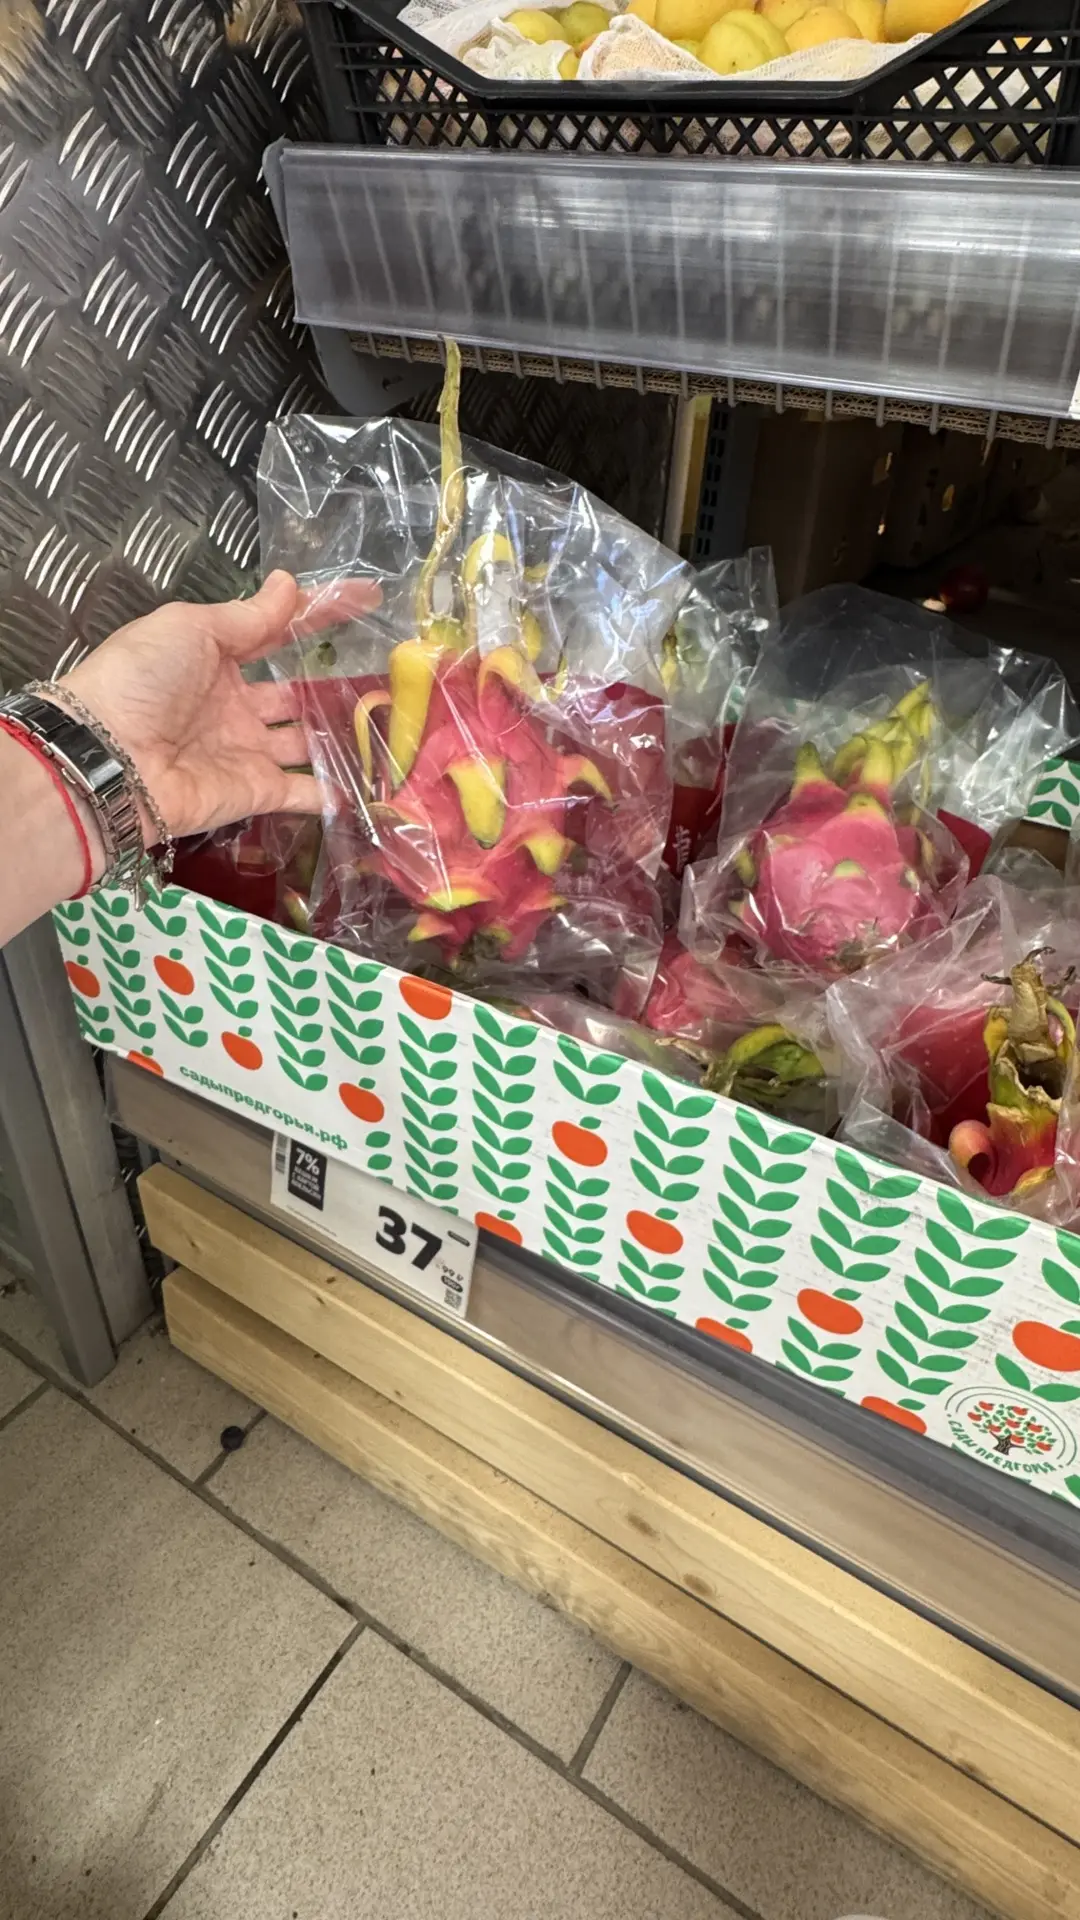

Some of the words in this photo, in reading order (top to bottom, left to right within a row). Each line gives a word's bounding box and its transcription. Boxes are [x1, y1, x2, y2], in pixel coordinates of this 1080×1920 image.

[179, 1065, 348, 1150] садыпредгорья.рф
[296, 1147, 320, 1176] 7%
[375, 1205, 443, 1271] 37
